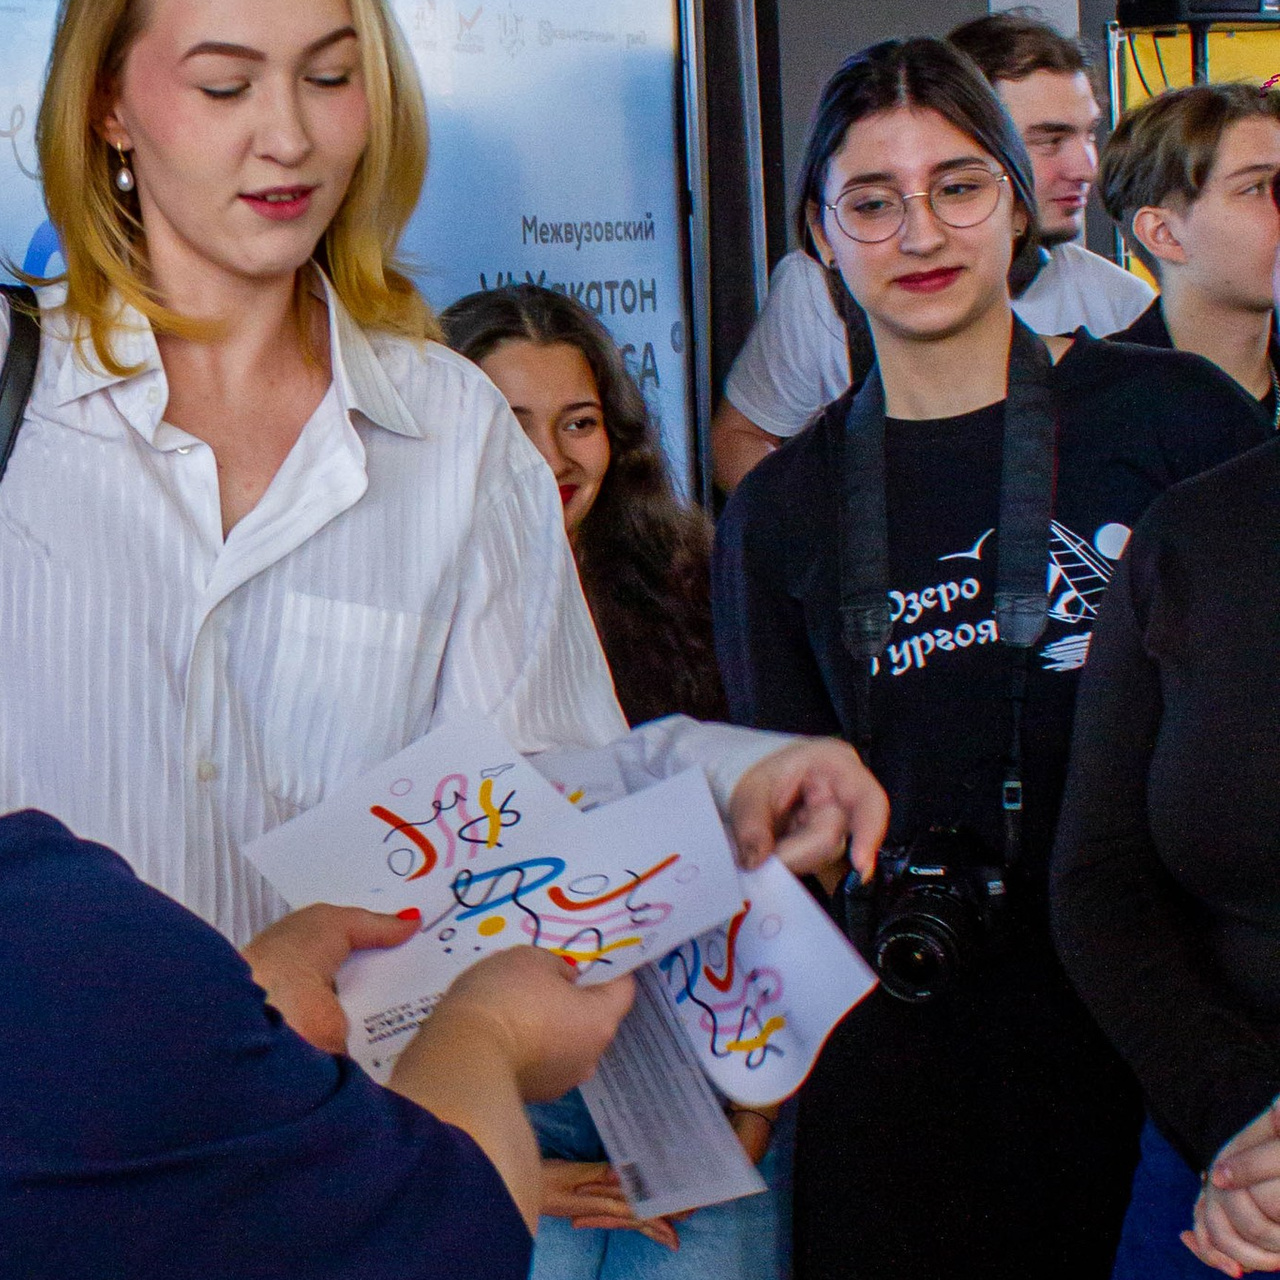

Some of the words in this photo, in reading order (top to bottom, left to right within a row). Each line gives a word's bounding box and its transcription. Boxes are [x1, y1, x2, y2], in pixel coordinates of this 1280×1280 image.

[522, 212, 656, 251] Межвузовский
[888, 577, 981, 624] Озеро
[871, 619, 1000, 677] ургоя
